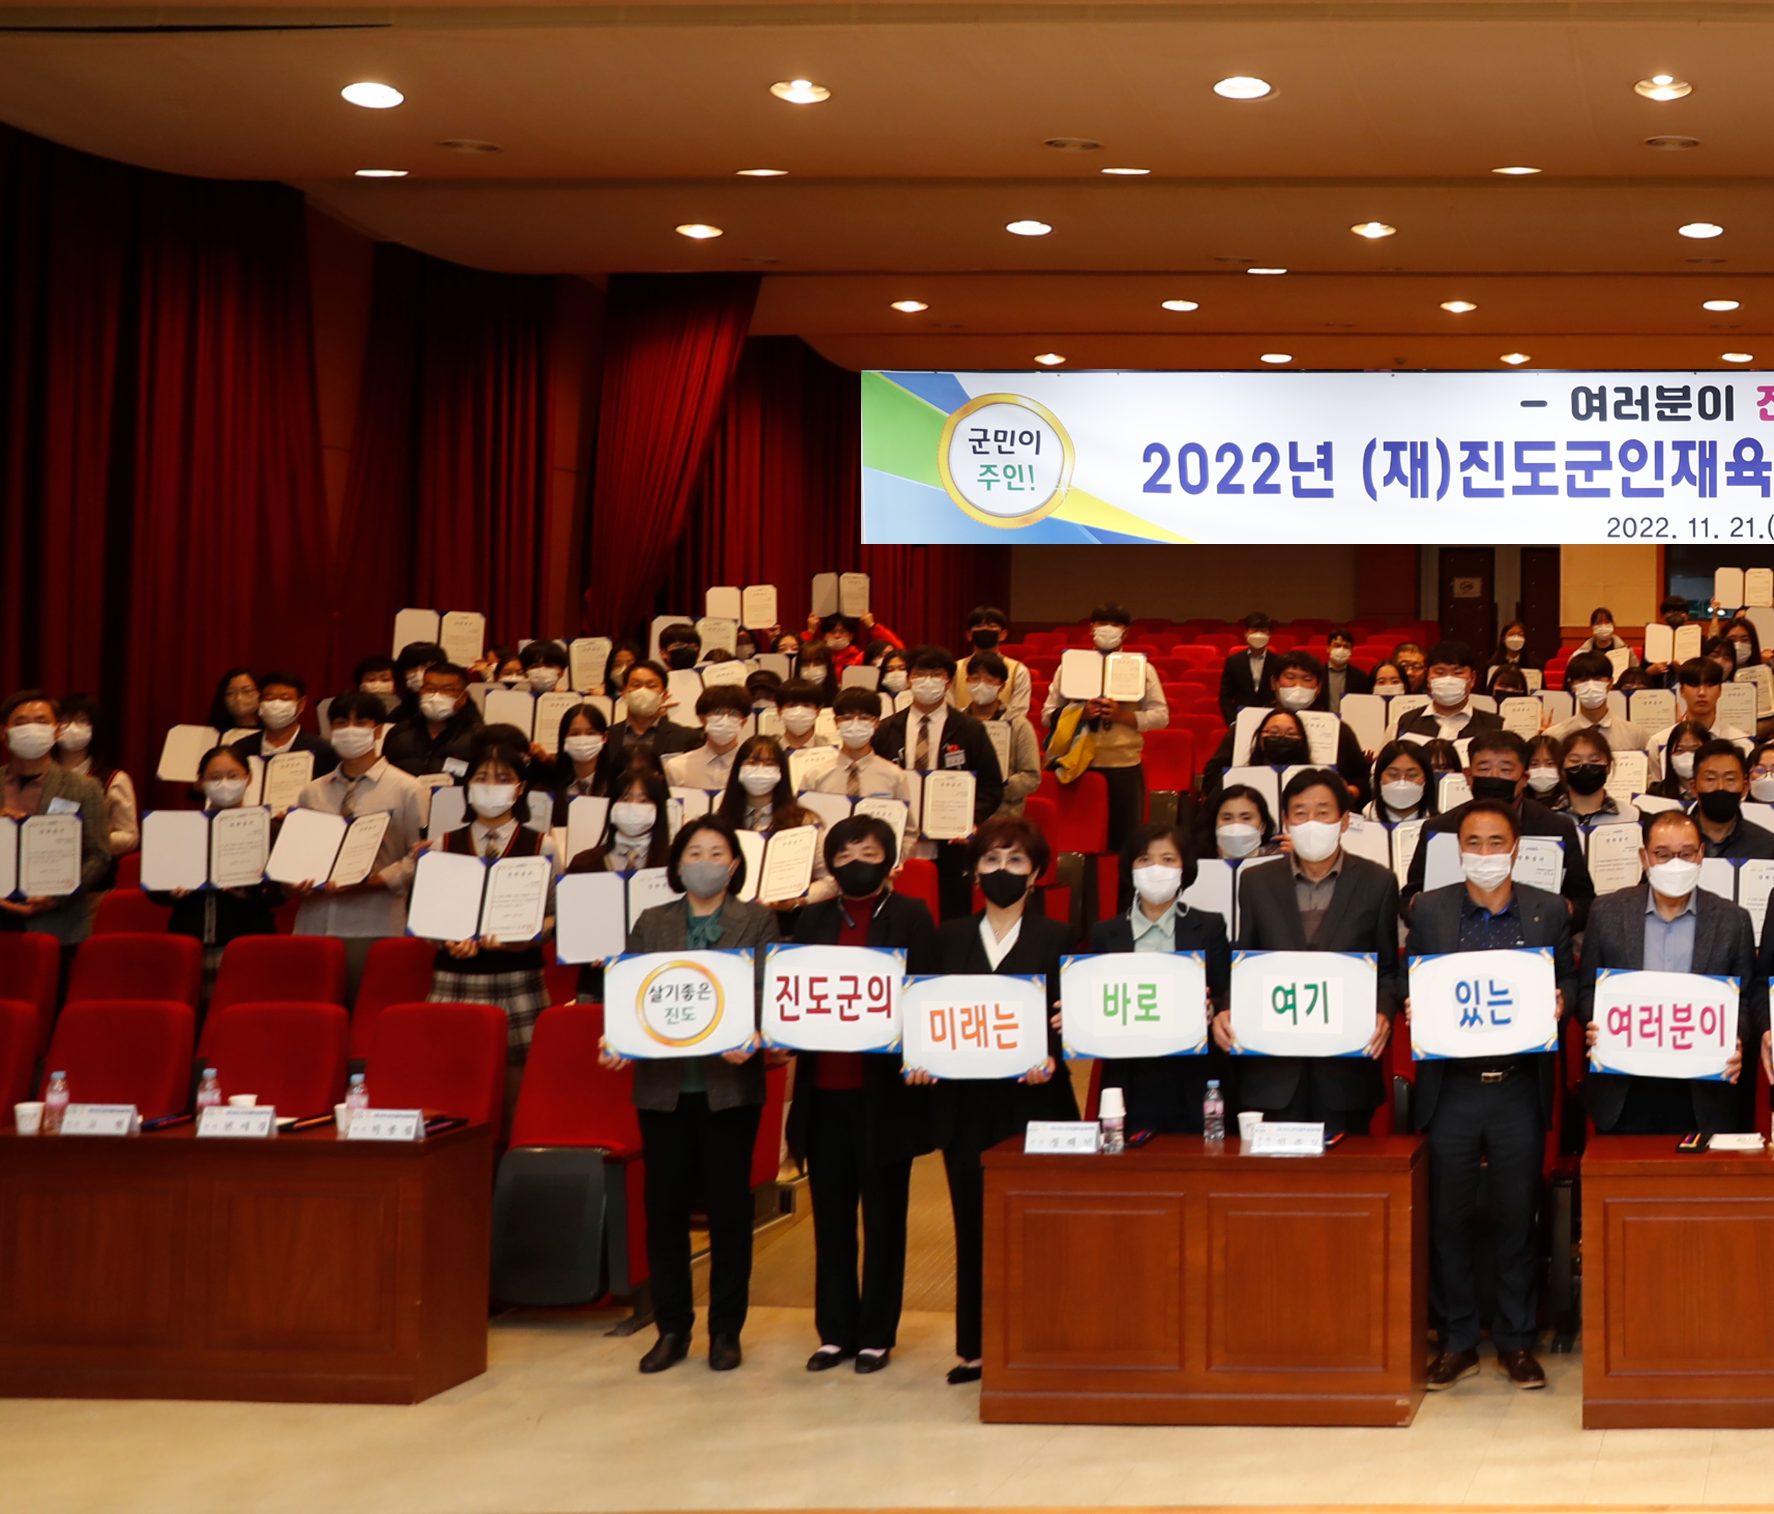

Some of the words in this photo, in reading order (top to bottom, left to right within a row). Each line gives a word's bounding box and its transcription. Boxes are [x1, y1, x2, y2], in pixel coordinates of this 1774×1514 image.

[1571, 385, 1734, 421] 여러분이
[969, 428, 1040, 455] 군민이
[978, 465, 1035, 491] 주인!
[1143, 441, 1334, 498] 2022년
[1608, 517, 1676, 539] 2022.
[1689, 518, 1718, 539] 11.
[648, 982, 712, 1002] 살기좋은
[776, 976, 891, 1021] 진도군의
[1104, 983, 1160, 1025] 바로
[1272, 982, 1328, 1025] 여기
[1456, 980, 1512, 1026] 있는
[665, 1007, 696, 1025] 진도
[930, 1004, 1019, 1050] 미래는
[1608, 1004, 1724, 1050] 여러분이
